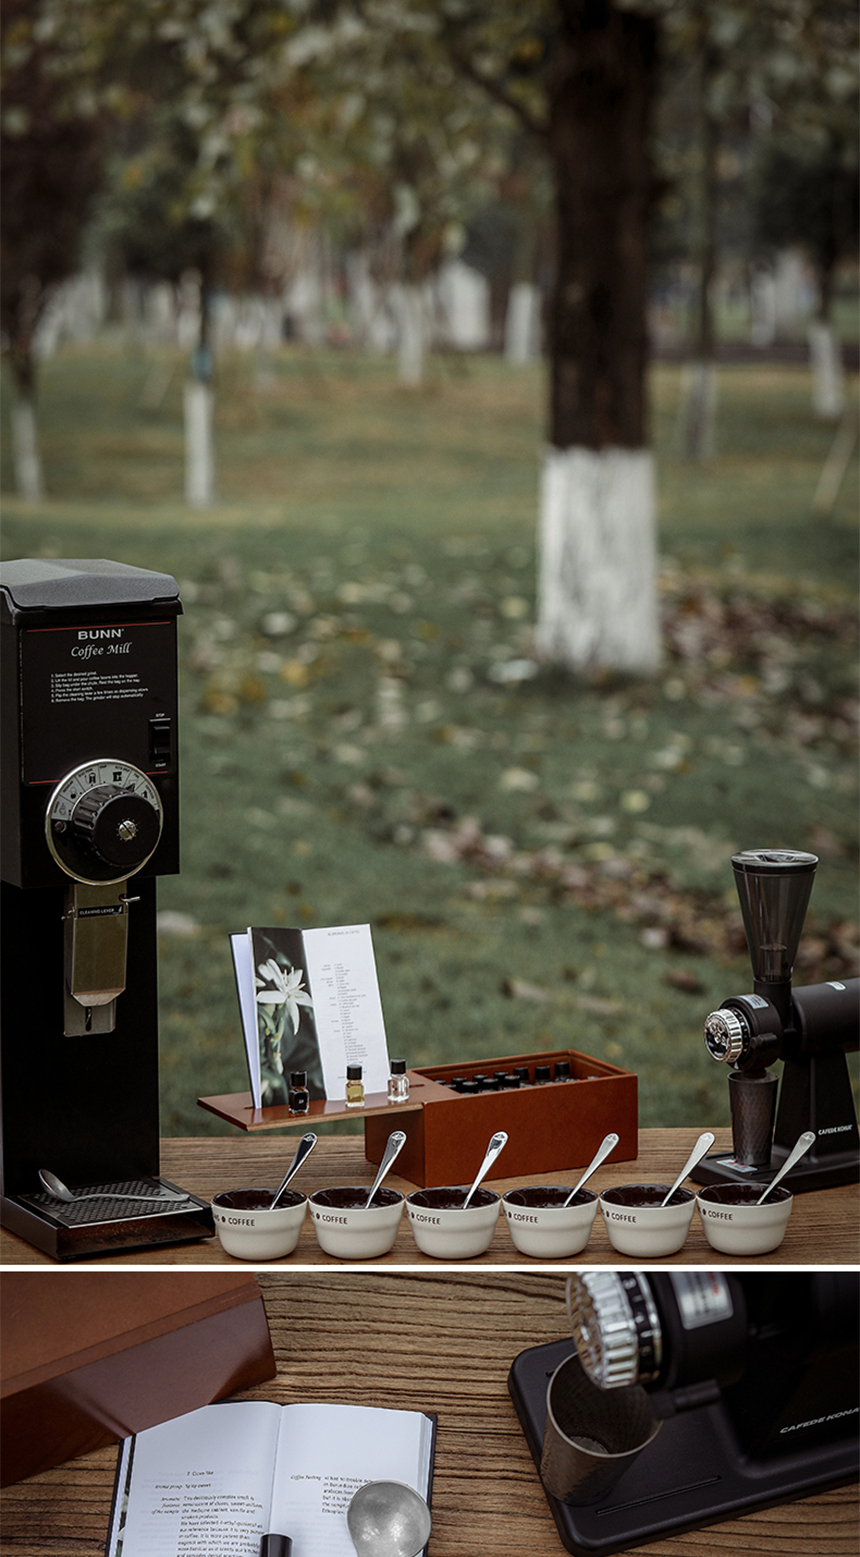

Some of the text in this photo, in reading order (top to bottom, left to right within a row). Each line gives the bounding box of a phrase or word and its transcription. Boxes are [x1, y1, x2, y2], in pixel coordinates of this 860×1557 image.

[78, 629, 121, 640] BUNN
[71, 642, 132, 660] Coffee Mill
[322, 1214, 348, 1224] COFFEE
[416, 1214, 440, 1225] COFFEE
[513, 1214, 538, 1223] COFFEE
[611, 1213, 636, 1223] COFFEE
[708, 1211, 733, 1220] COFFEE
[228, 1218, 255, 1226] COFFEE
